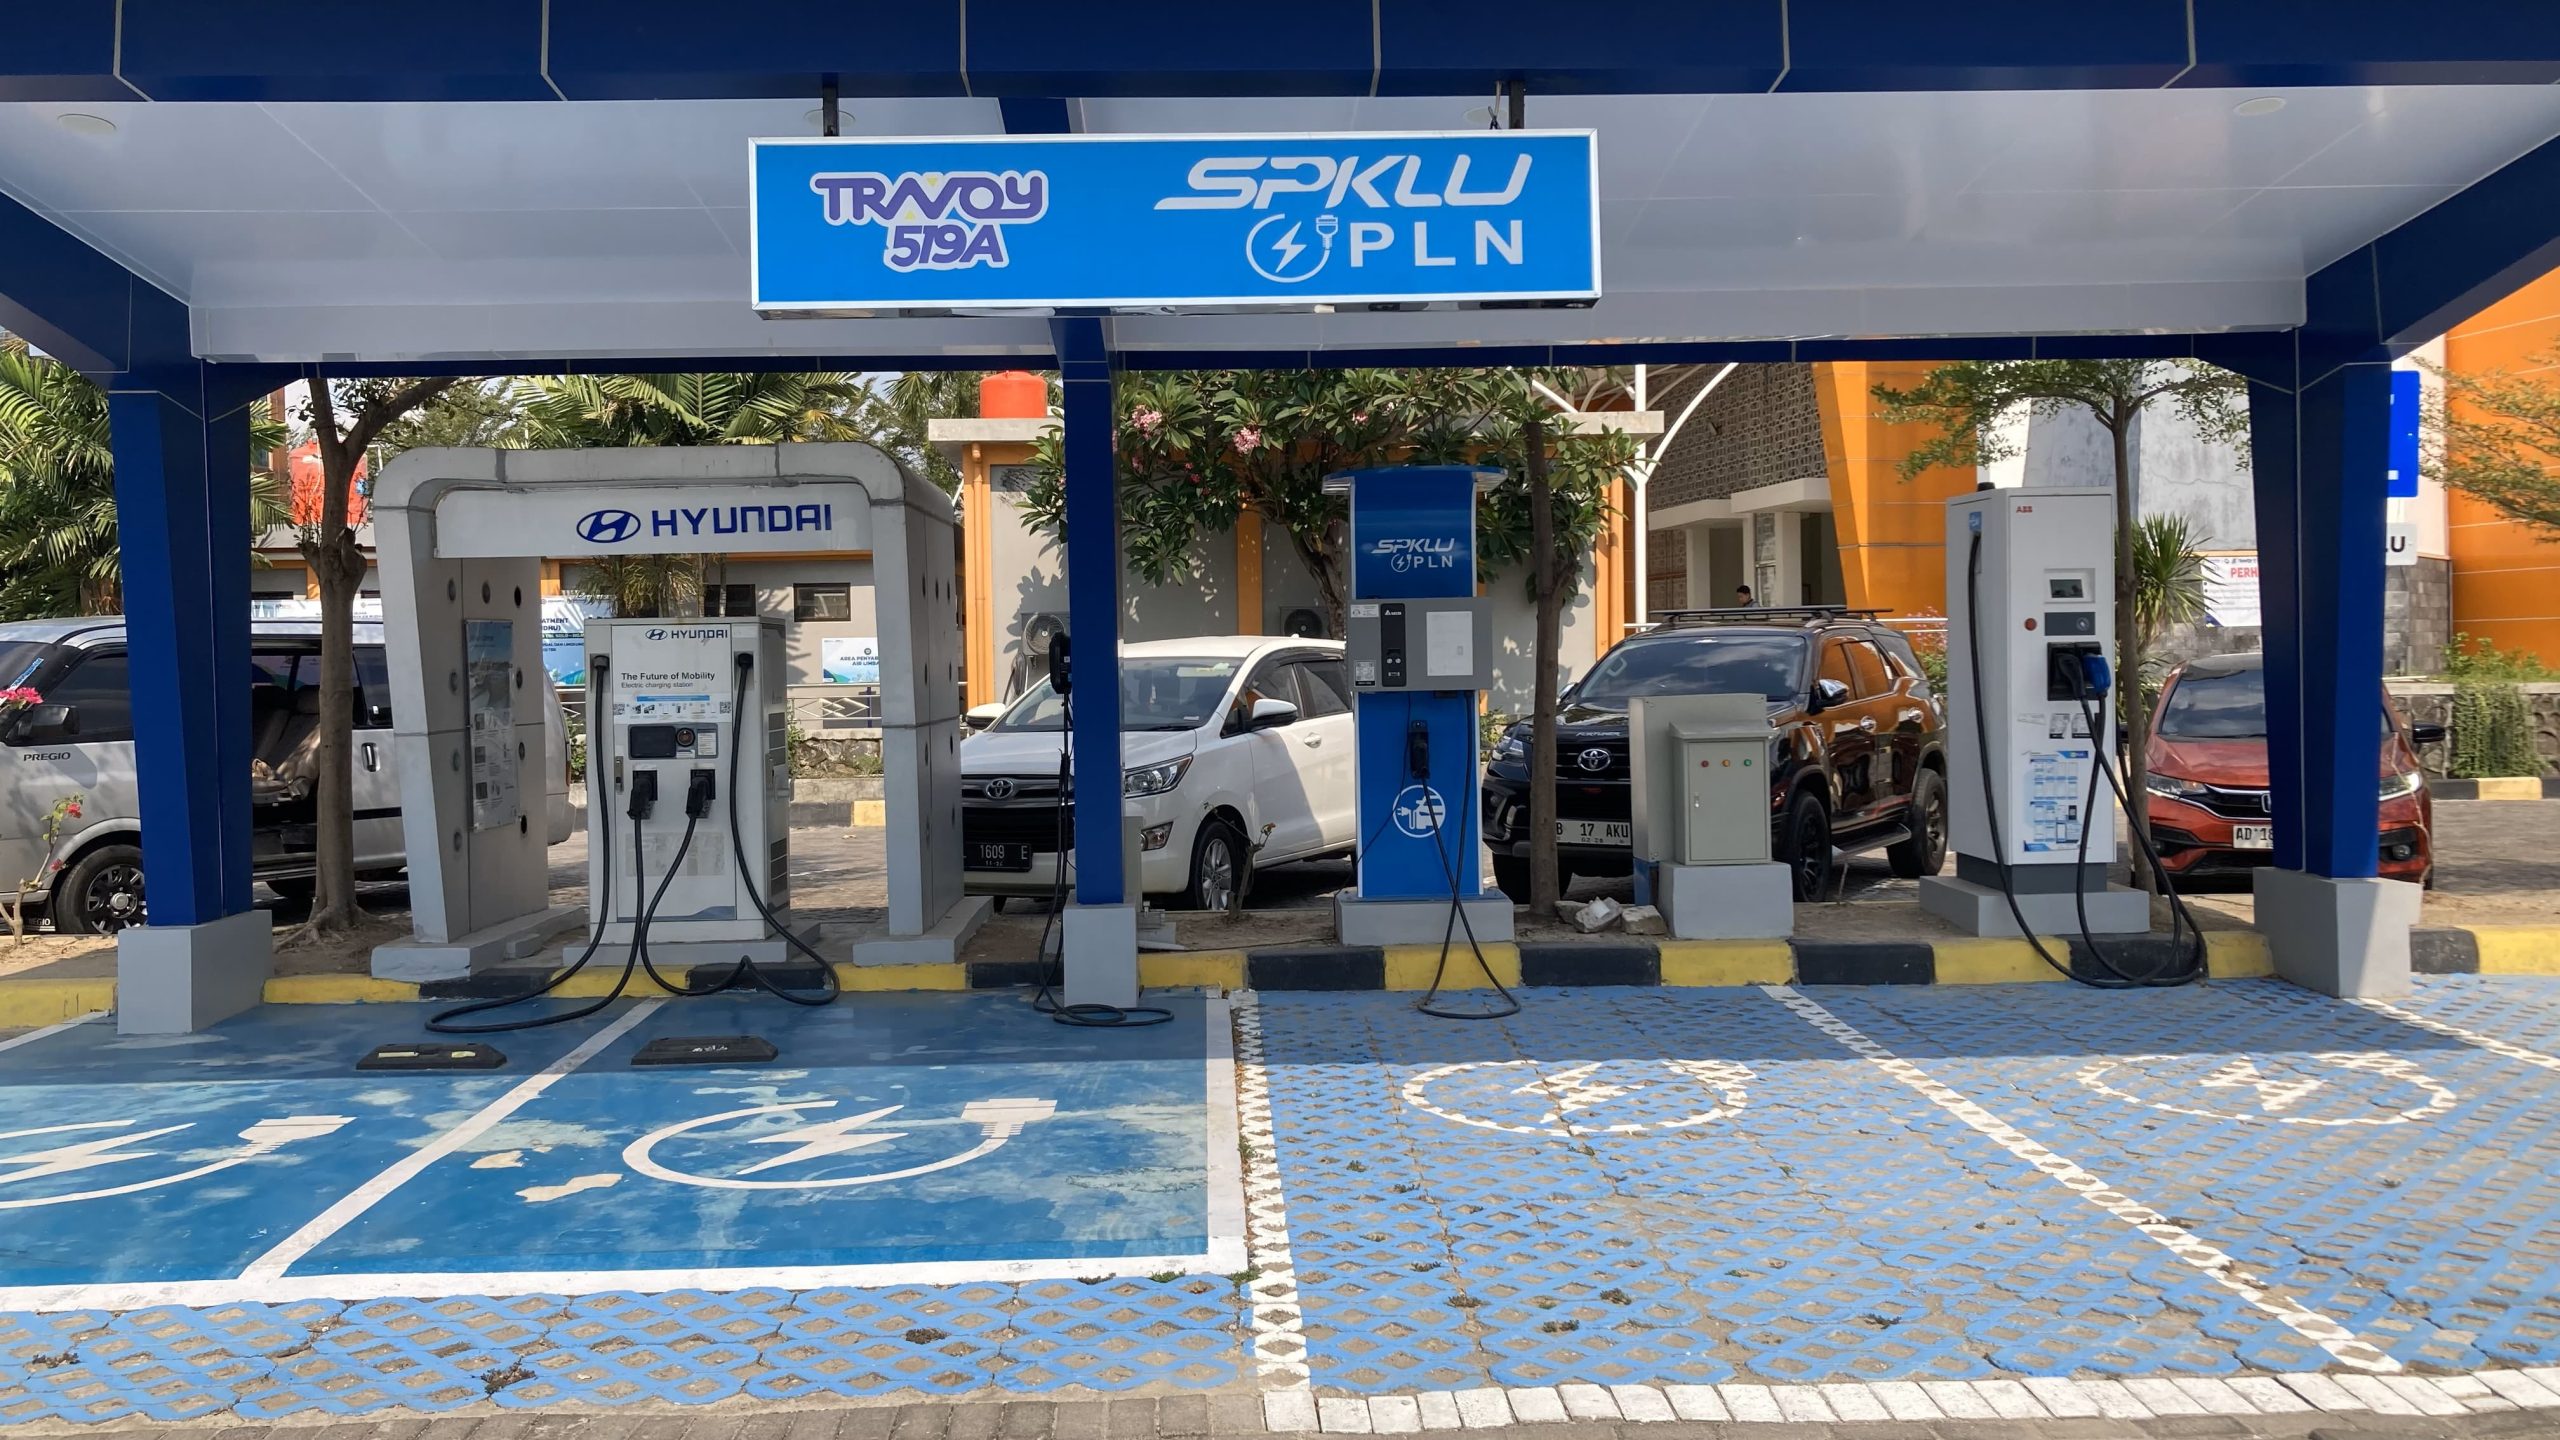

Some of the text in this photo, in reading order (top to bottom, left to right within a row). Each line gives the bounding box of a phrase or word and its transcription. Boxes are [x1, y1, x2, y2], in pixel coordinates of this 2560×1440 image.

[1153, 153, 1533, 210] SPKLU
[810, 171, 1048, 225] TRAVOY
[884, 222, 1008, 271] 519A
[1349, 219, 1524, 267] PLN
[651, 503, 832, 537] HYUNDAI
[1370, 537, 1455, 554] SPKLU
[2385, 535, 2406, 553] U
[1413, 555, 1453, 568] PLN
[671, 629, 728, 639] HYUNDAI
[621, 671, 716, 682] The Future of Mobility
[23, 752, 71, 761] PREGIO
[1580, 823, 1595, 836] 17
[1606, 823, 1629, 838] AKU
[2236, 828, 2252, 840] AD
[980, 844, 1028, 860] 1609 E
